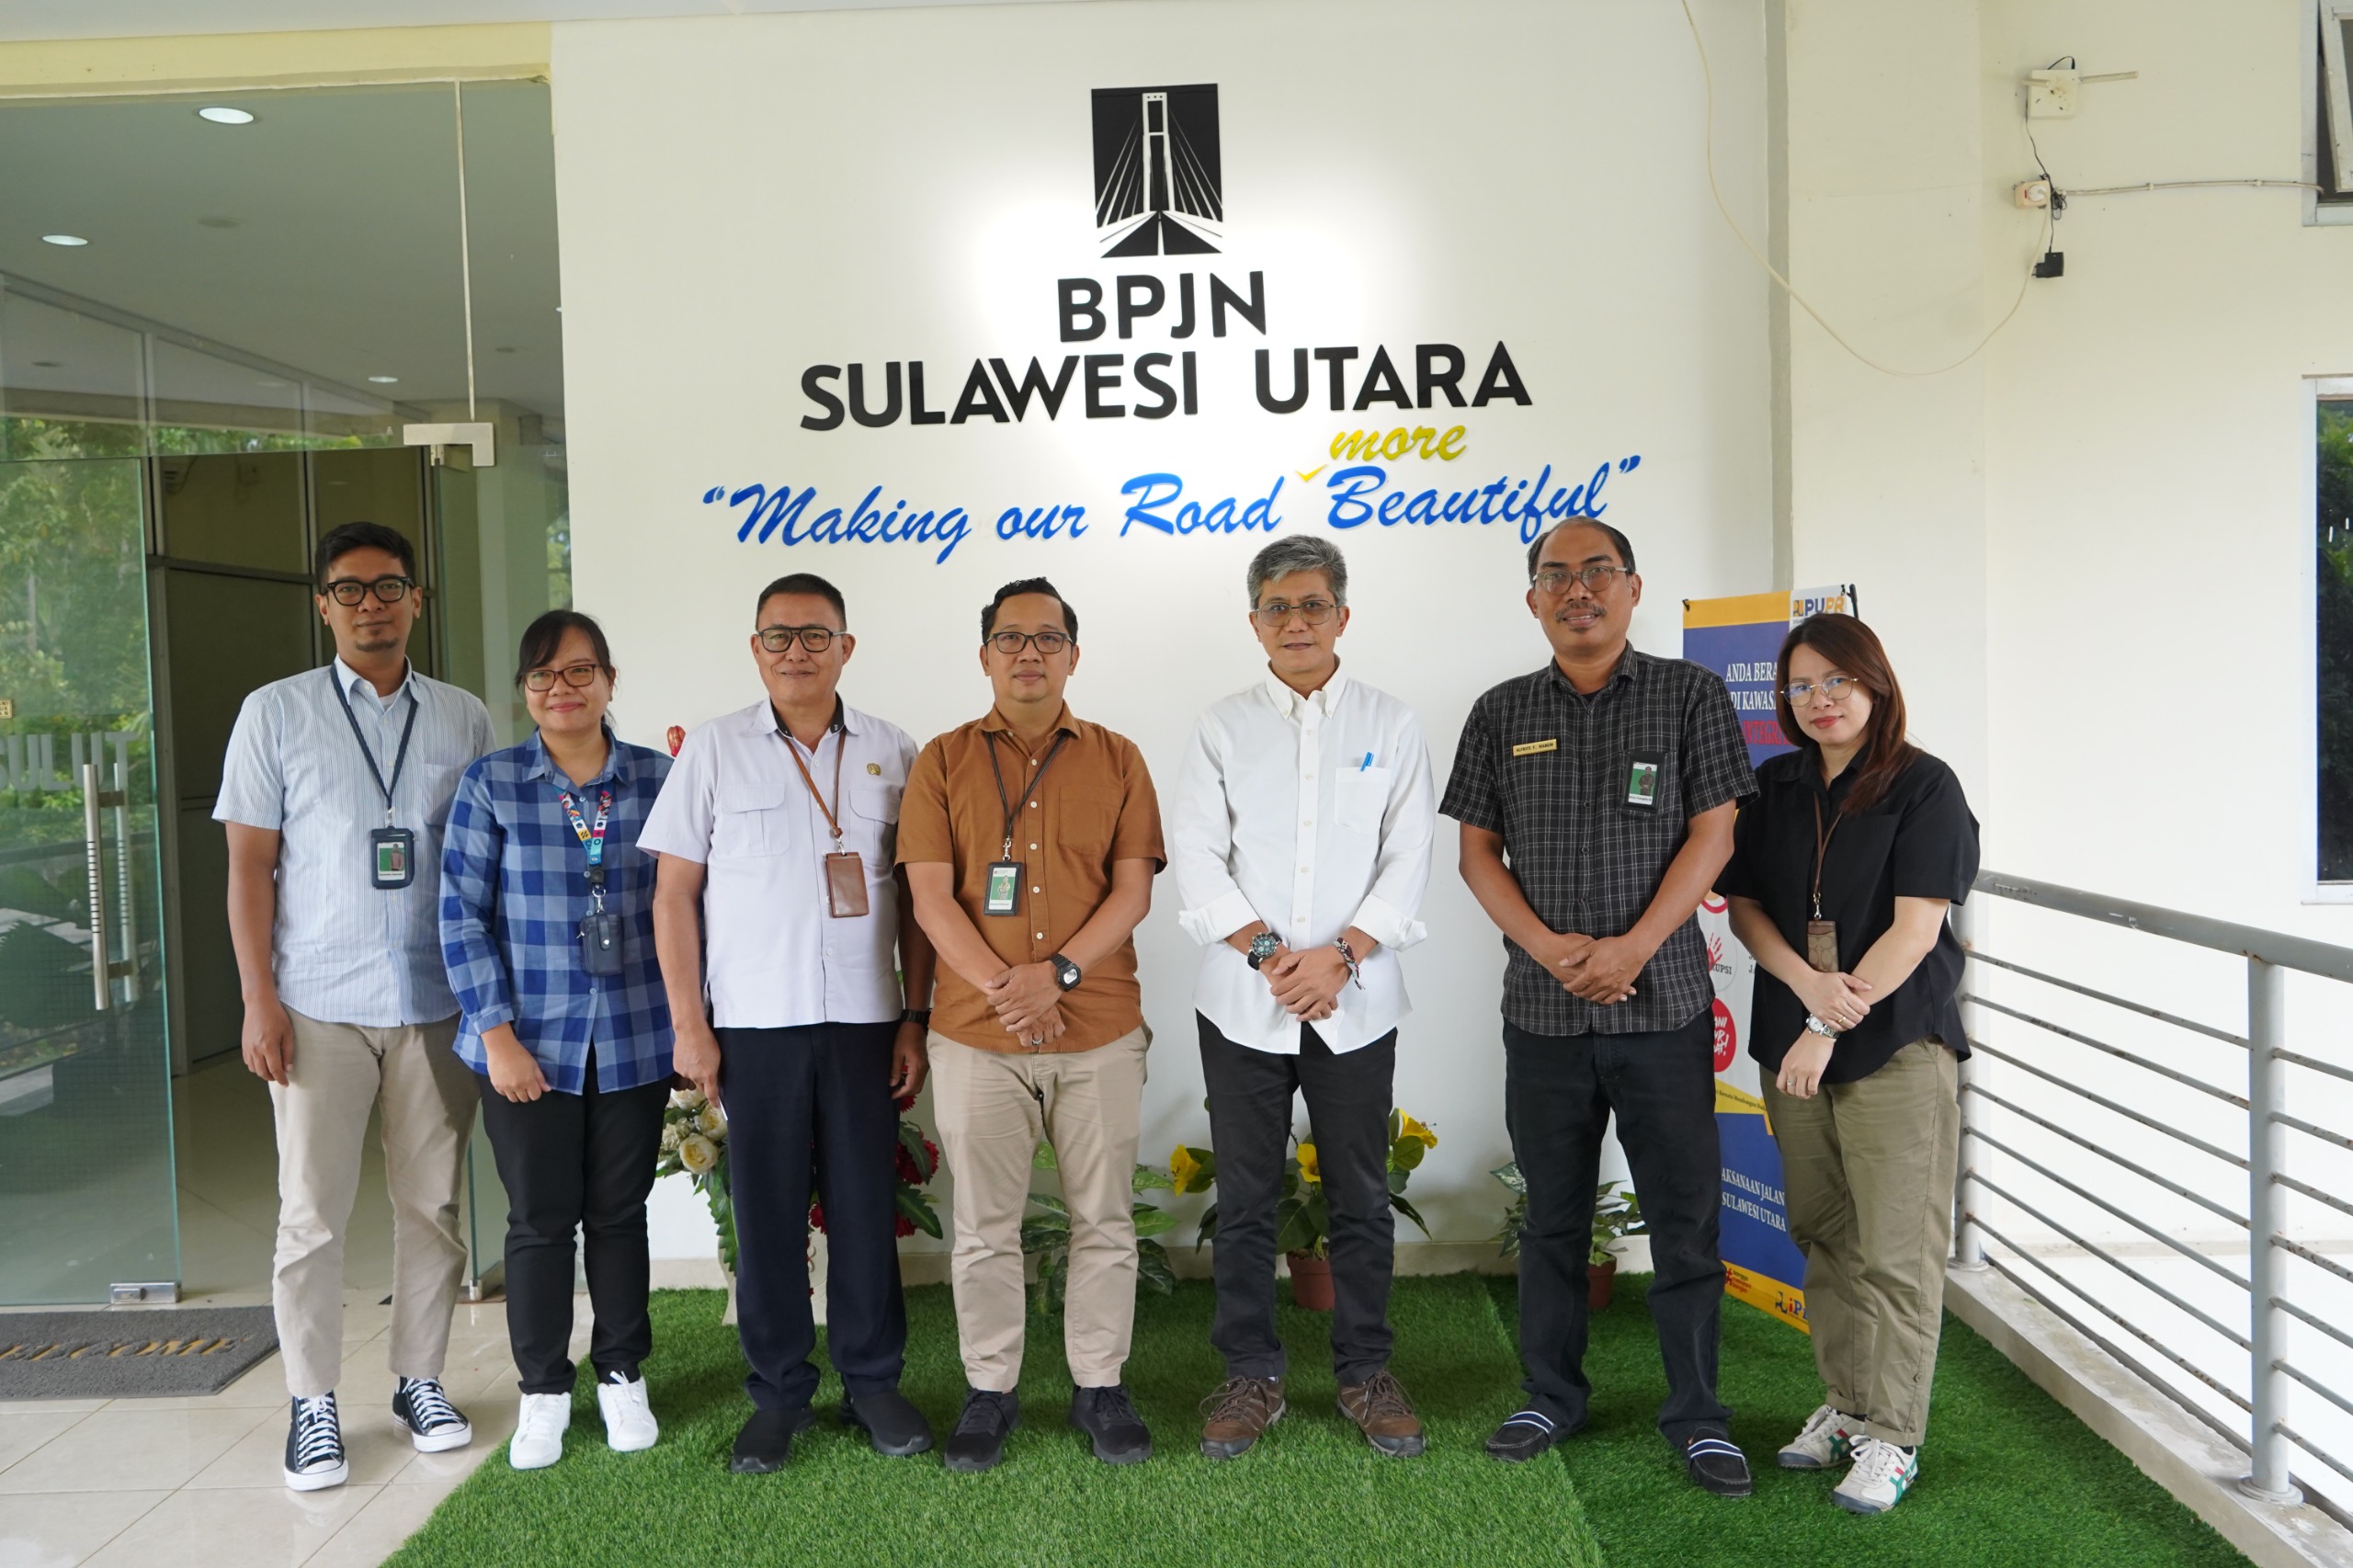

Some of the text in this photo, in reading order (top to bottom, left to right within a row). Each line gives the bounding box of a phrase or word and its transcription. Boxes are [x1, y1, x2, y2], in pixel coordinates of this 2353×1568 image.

[1058, 271, 1266, 343] BPJN
[801, 341, 1533, 432] SULAWESI UTARA
[1330, 425, 1467, 462] more
[996, 504, 1088, 540] our
[1120, 472, 1286, 538] Road
[1804, 596, 1844, 616] PUPR
[1725, 664, 1752, 682] ANDA
[1731, 691, 1741, 710] DI
[1722, 1167, 1785, 1206] AKSANAAN JALAN
[1722, 1191, 1787, 1232] SULAWESI UTARA
